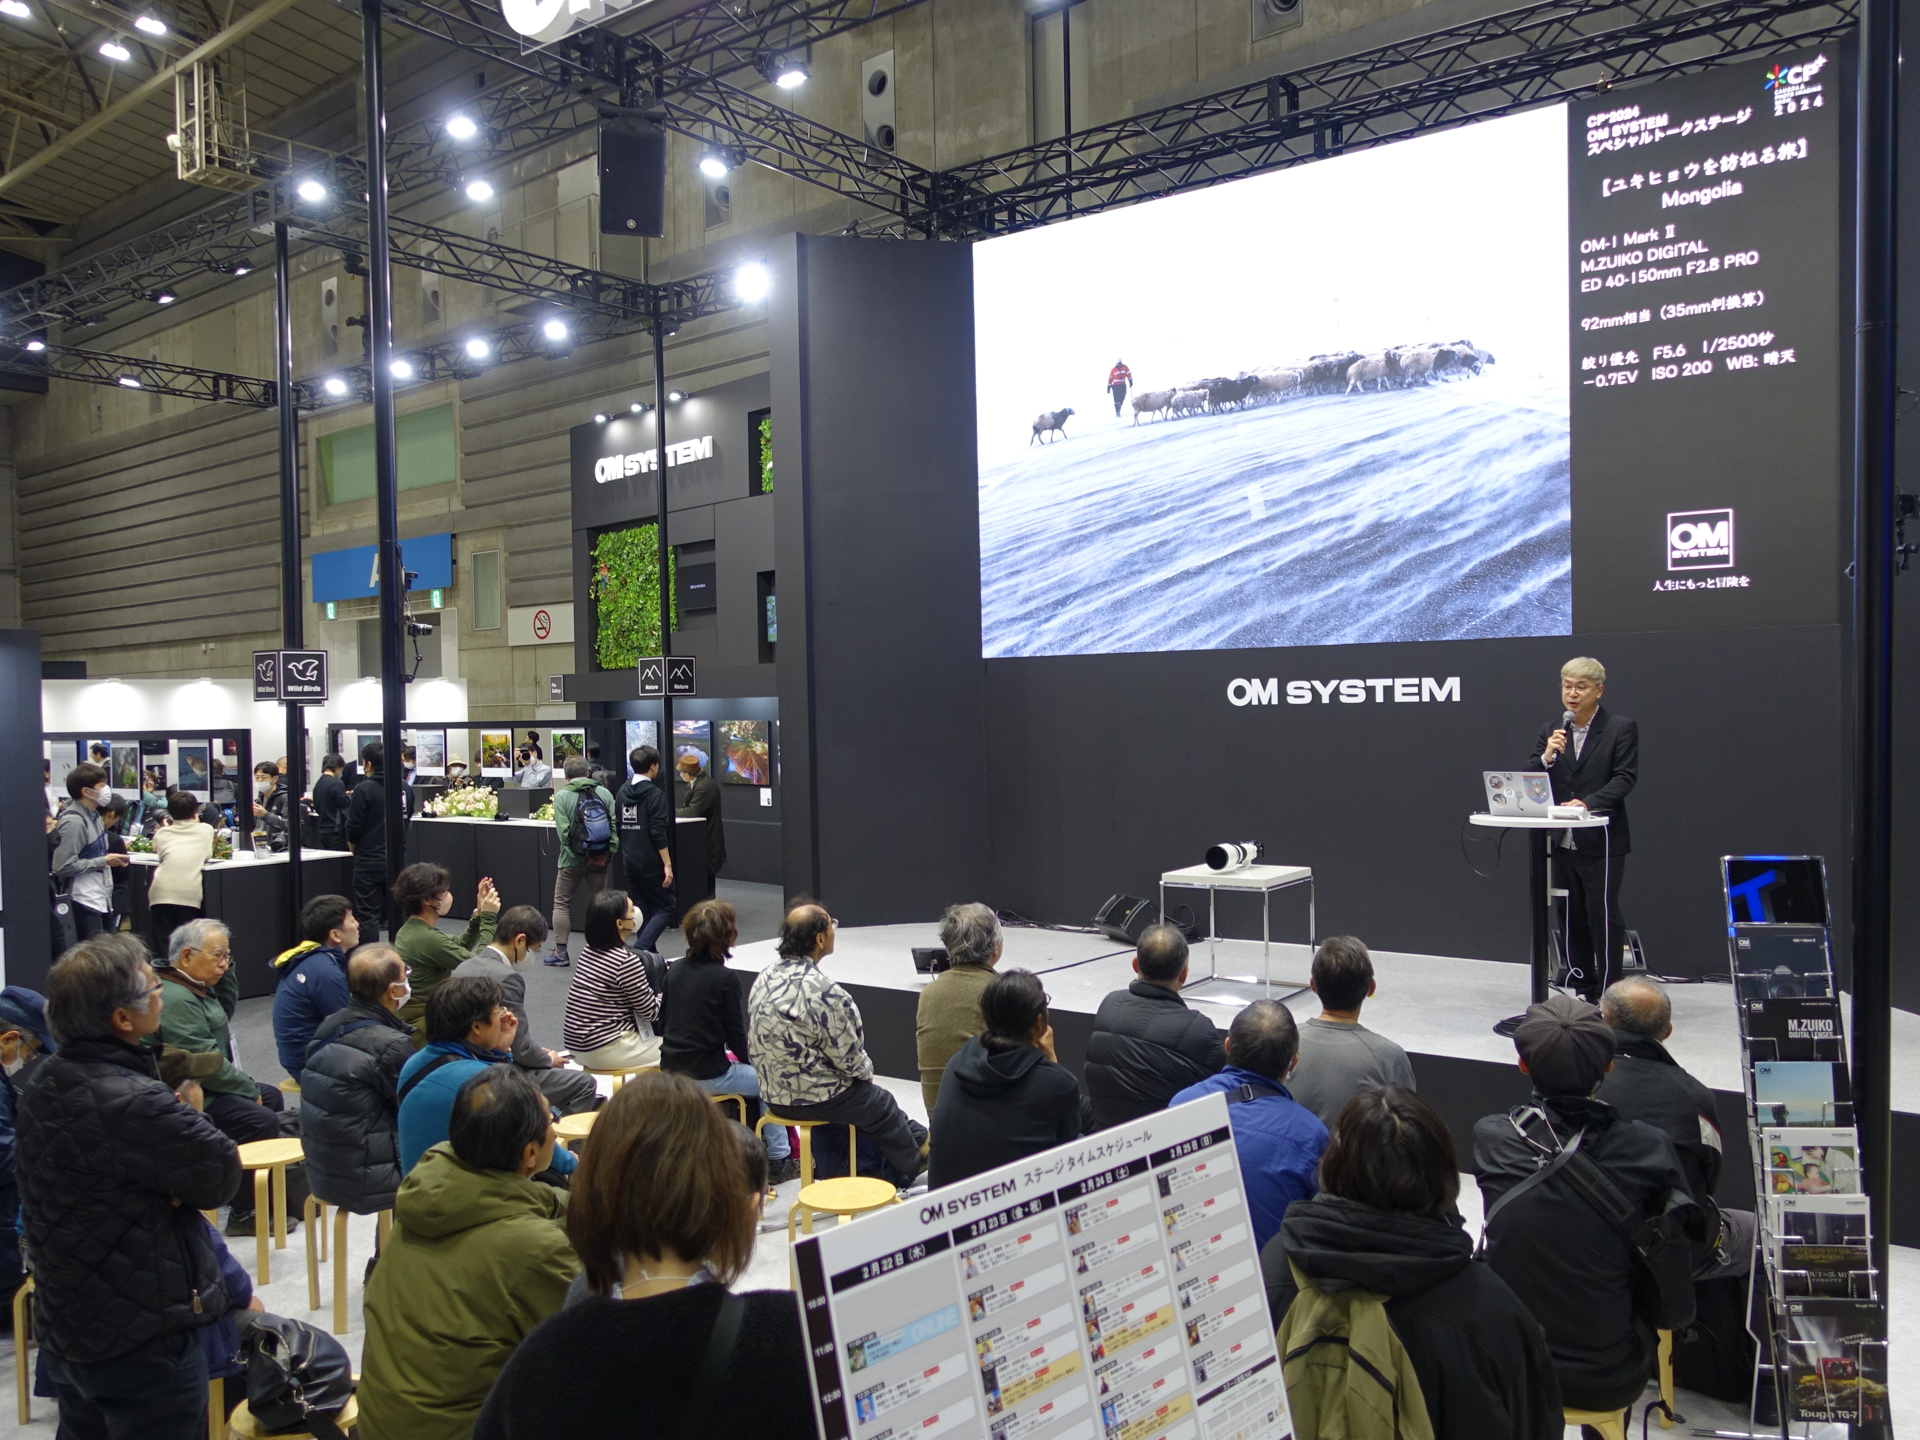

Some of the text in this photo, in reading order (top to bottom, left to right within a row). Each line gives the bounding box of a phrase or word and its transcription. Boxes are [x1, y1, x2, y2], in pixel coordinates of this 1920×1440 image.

[1774, 94, 1824, 116] 2024
[1586, 114, 1668, 142] OM SYSTEM
[1587, 106, 1752, 156] スペシャルトークステージ
[1602, 138, 1808, 197] 【ユキヒョウを訪ねる旅】
[1662, 180, 1742, 208] Mongolia
[1580, 236, 1617, 253] OM-1
[1624, 228, 1658, 246] Mark
[1580, 240, 1709, 272] M.ZUIKO DIGITAL
[1580, 251, 1760, 292] ED 40-150mm F2.8 PRO
[1580, 308, 1652, 331] 92mm相当
[1582, 330, 1775, 370] 絞り優先 F5.6 1/2500秒
[1652, 364, 1678, 380] ISO
[1682, 360, 1713, 377] 200
[1763, 349, 1796, 366] 晴天
[595, 454, 624, 484] OM
[1670, 521, 1728, 550] OM
[1672, 547, 1728, 558] SYSTEM
[1653, 576, 1750, 592] 人生にもっと冒険を
[1227, 677, 1461, 706] OM SYSTEM
[1788, 1019, 1833, 1032] M.ZUIKO
[920, 1130, 1152, 1225] OM SYSTEM ステージ タイムスケジュール
[807, 1296, 826, 1310] 10:00
[911, 1310, 958, 1341] ONLINE
[815, 1342, 834, 1356] 11:00
[822, 1390, 841, 1404] 12:00
[1799, 1409, 1858, 1420] Tough TG-7
